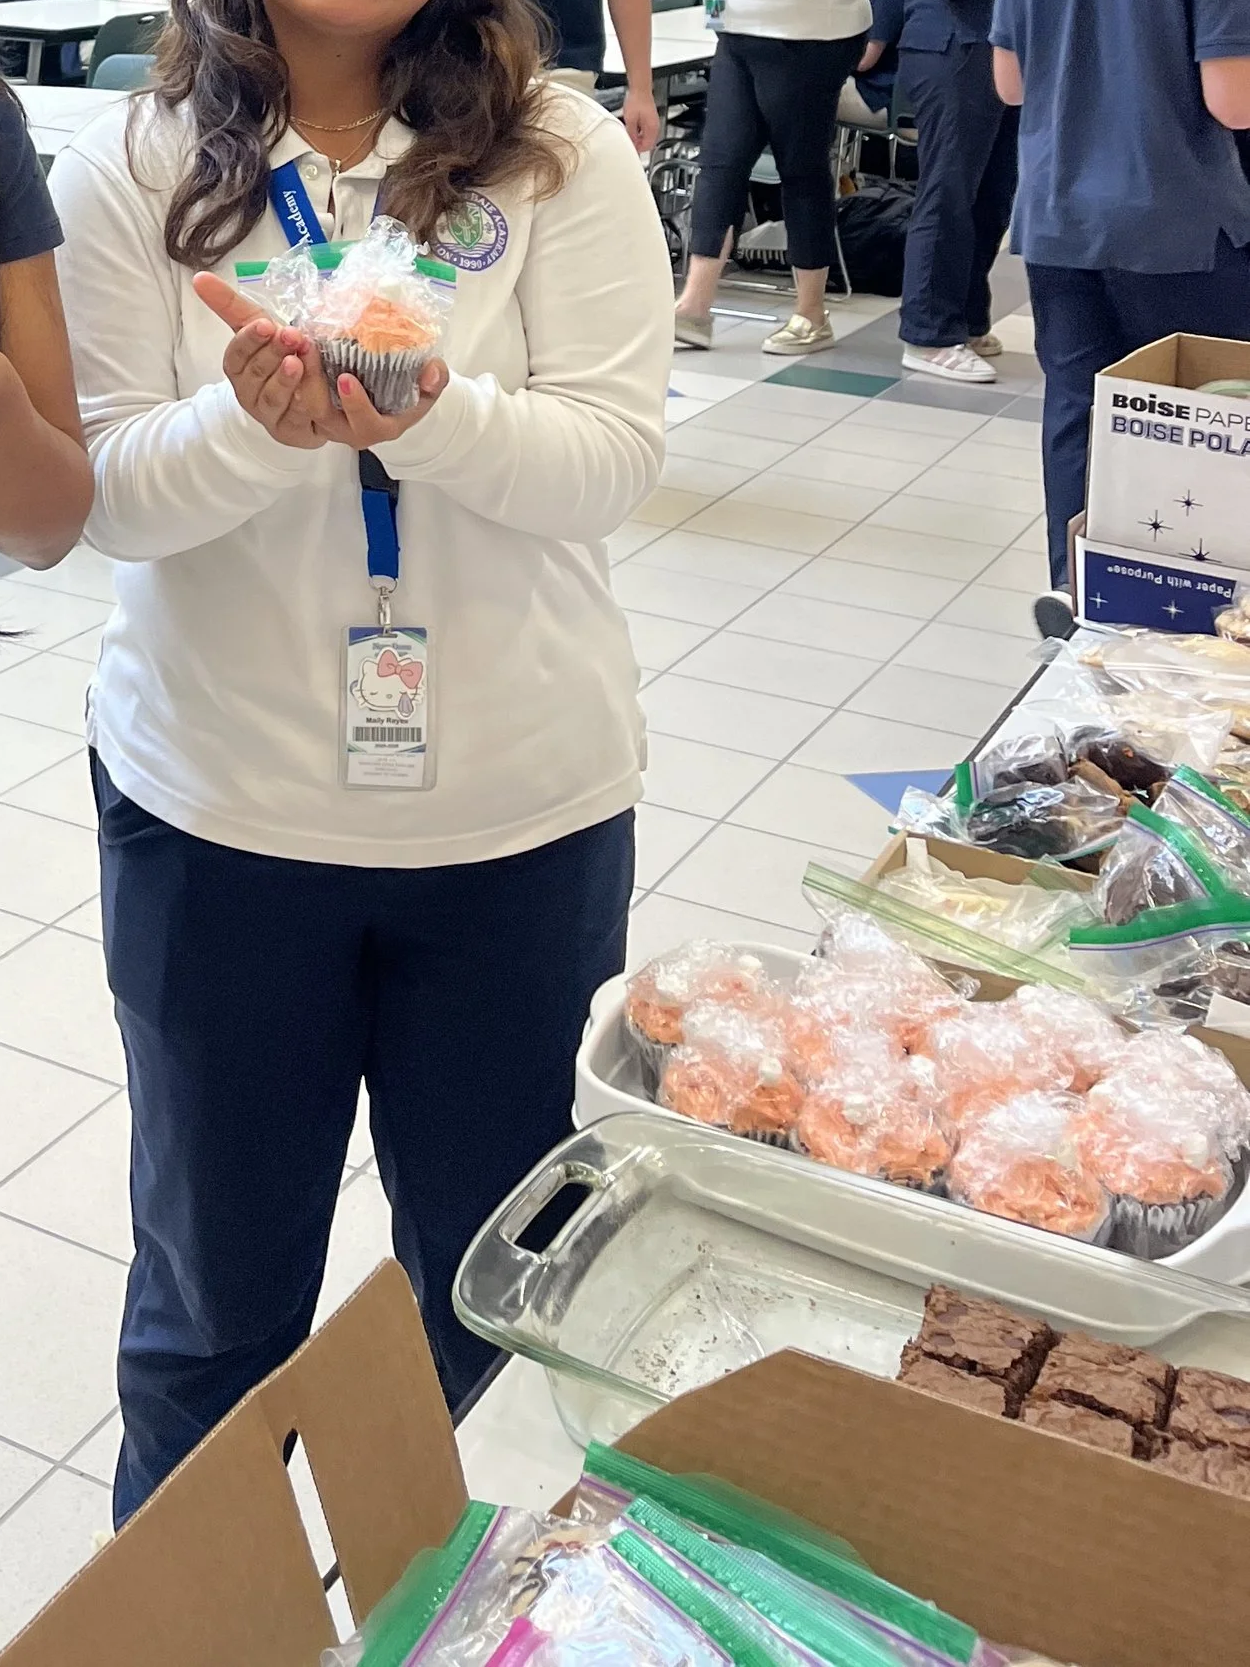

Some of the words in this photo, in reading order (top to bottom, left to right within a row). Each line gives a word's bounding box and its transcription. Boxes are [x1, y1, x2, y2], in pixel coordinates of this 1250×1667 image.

[486, 214, 506, 265] ACADEMY
[459, 256, 483, 270] 1990
[1111, 414, 1184, 446] BOISE
[1167, 575, 1192, 589] with
[1195, 582, 1232, 599] Paper
